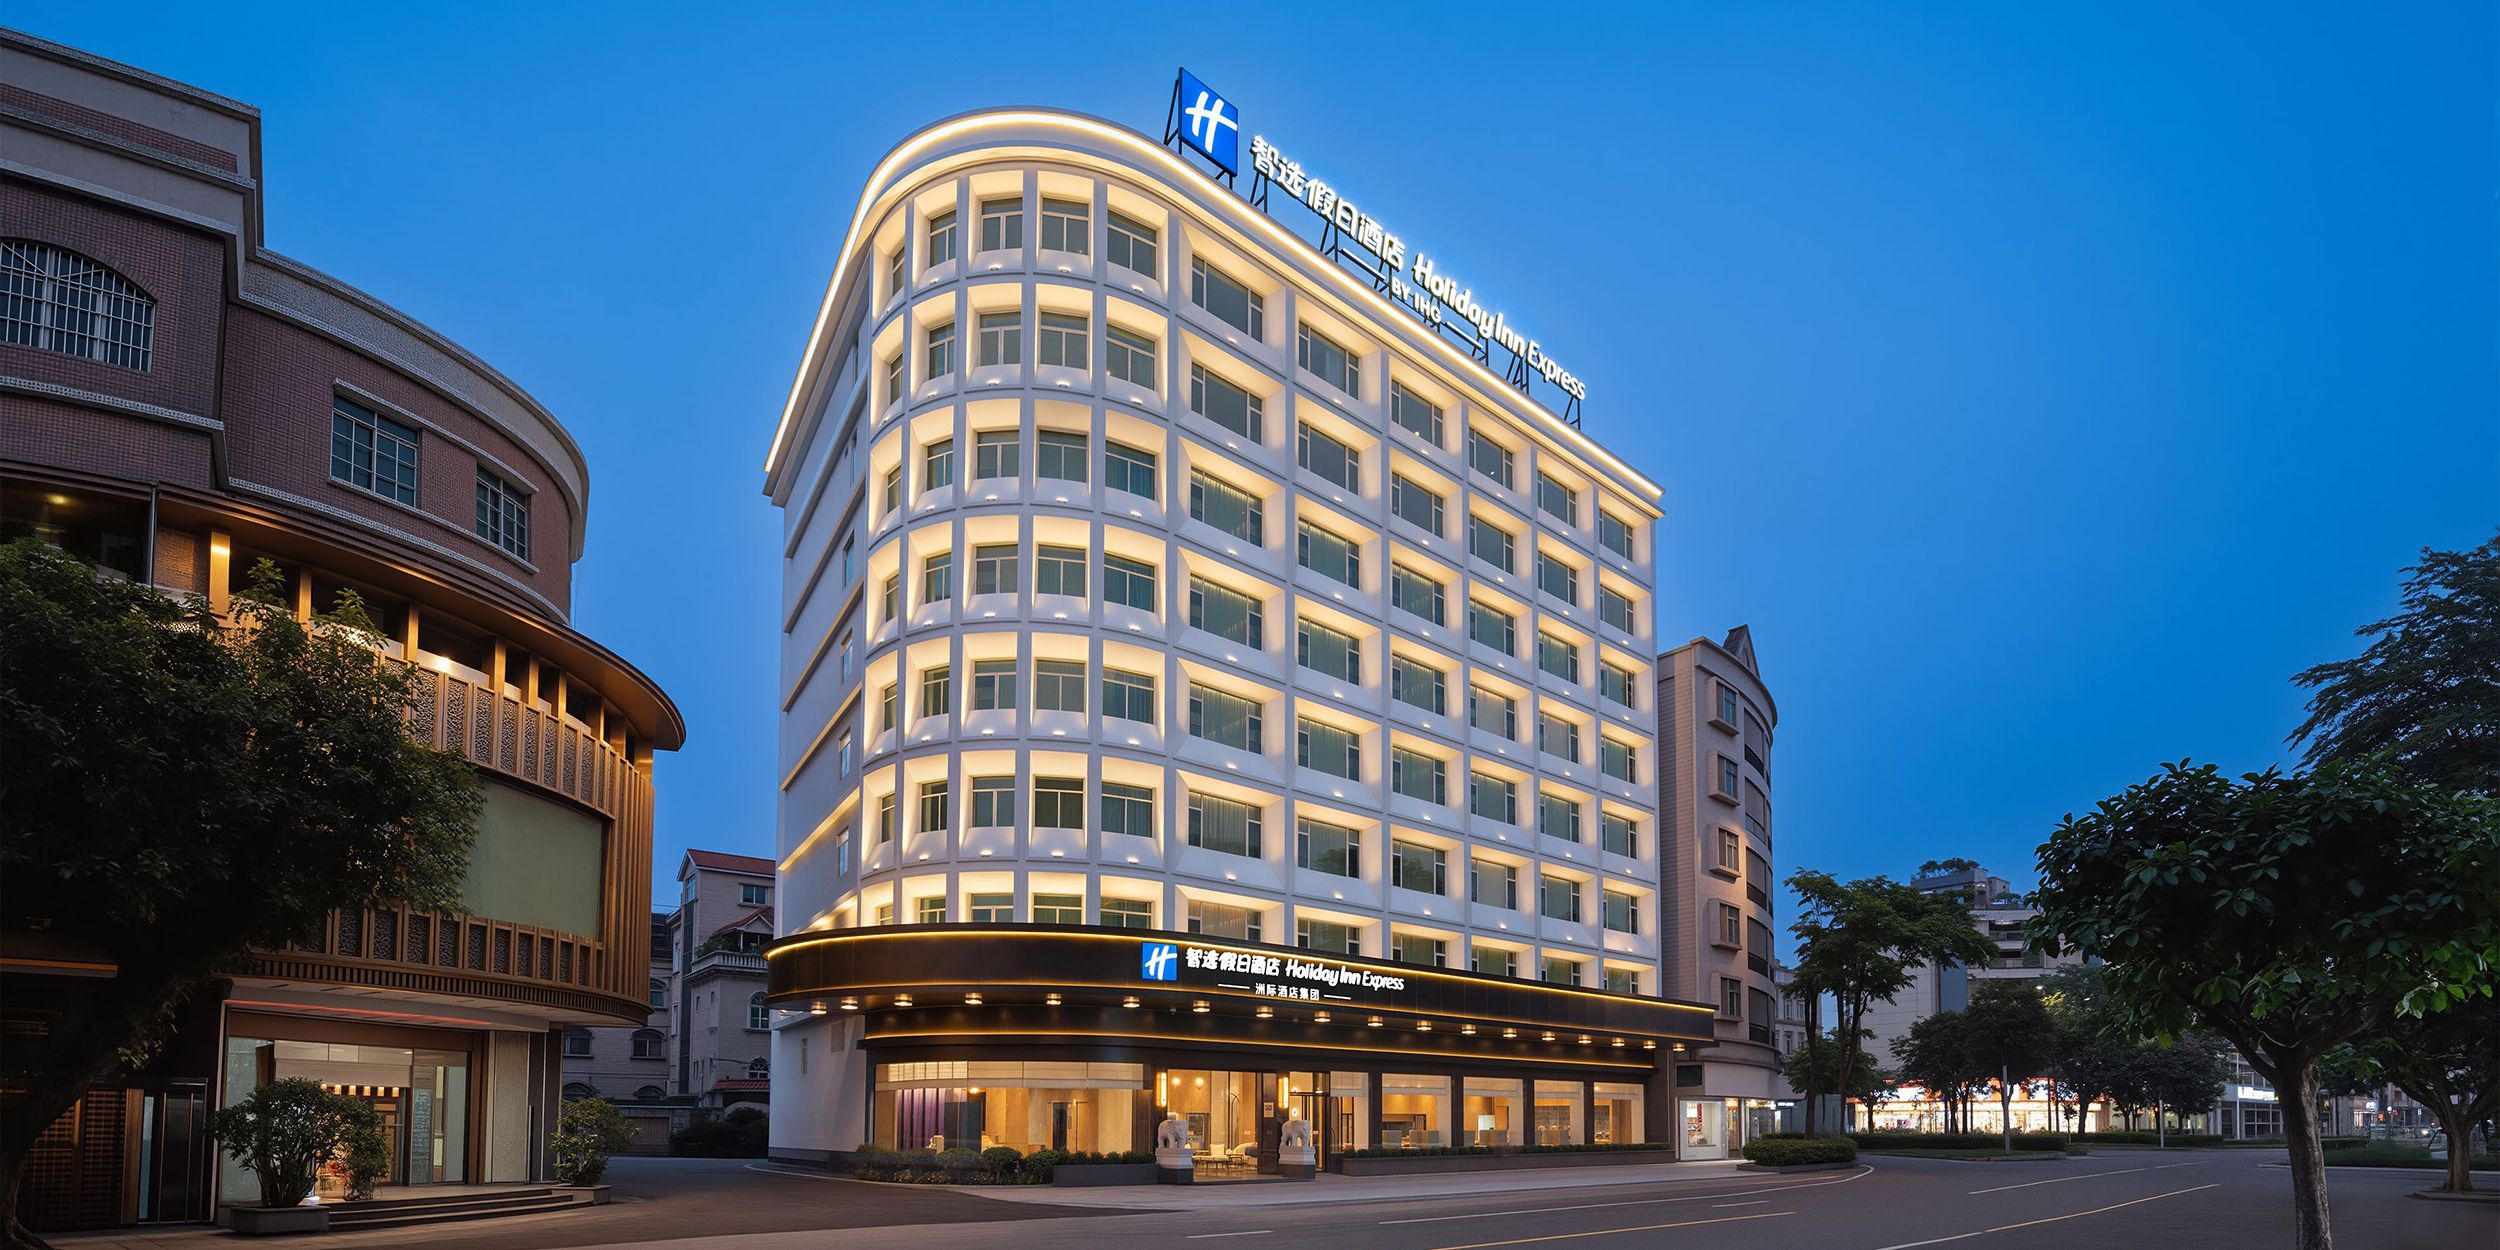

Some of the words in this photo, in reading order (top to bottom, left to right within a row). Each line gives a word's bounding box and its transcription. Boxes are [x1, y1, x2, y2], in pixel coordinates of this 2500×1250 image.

[1251, 135, 1405, 271] 智选假日酒店
[1391, 277, 1411, 300] BY
[1414, 292, 1442, 324] IHG
[1413, 253, 1494, 338] Holiday
[1495, 312, 1526, 357] Inn
[1527, 340, 1586, 400] Express
[1186, 947, 1280, 976] 智选假日酒店
[1285, 958, 1339, 986] Holiday
[1340, 965, 1361, 985] Inn
[1362, 970, 1405, 991] Express
[1255, 982, 1320, 1001] 洲际酒店集团
